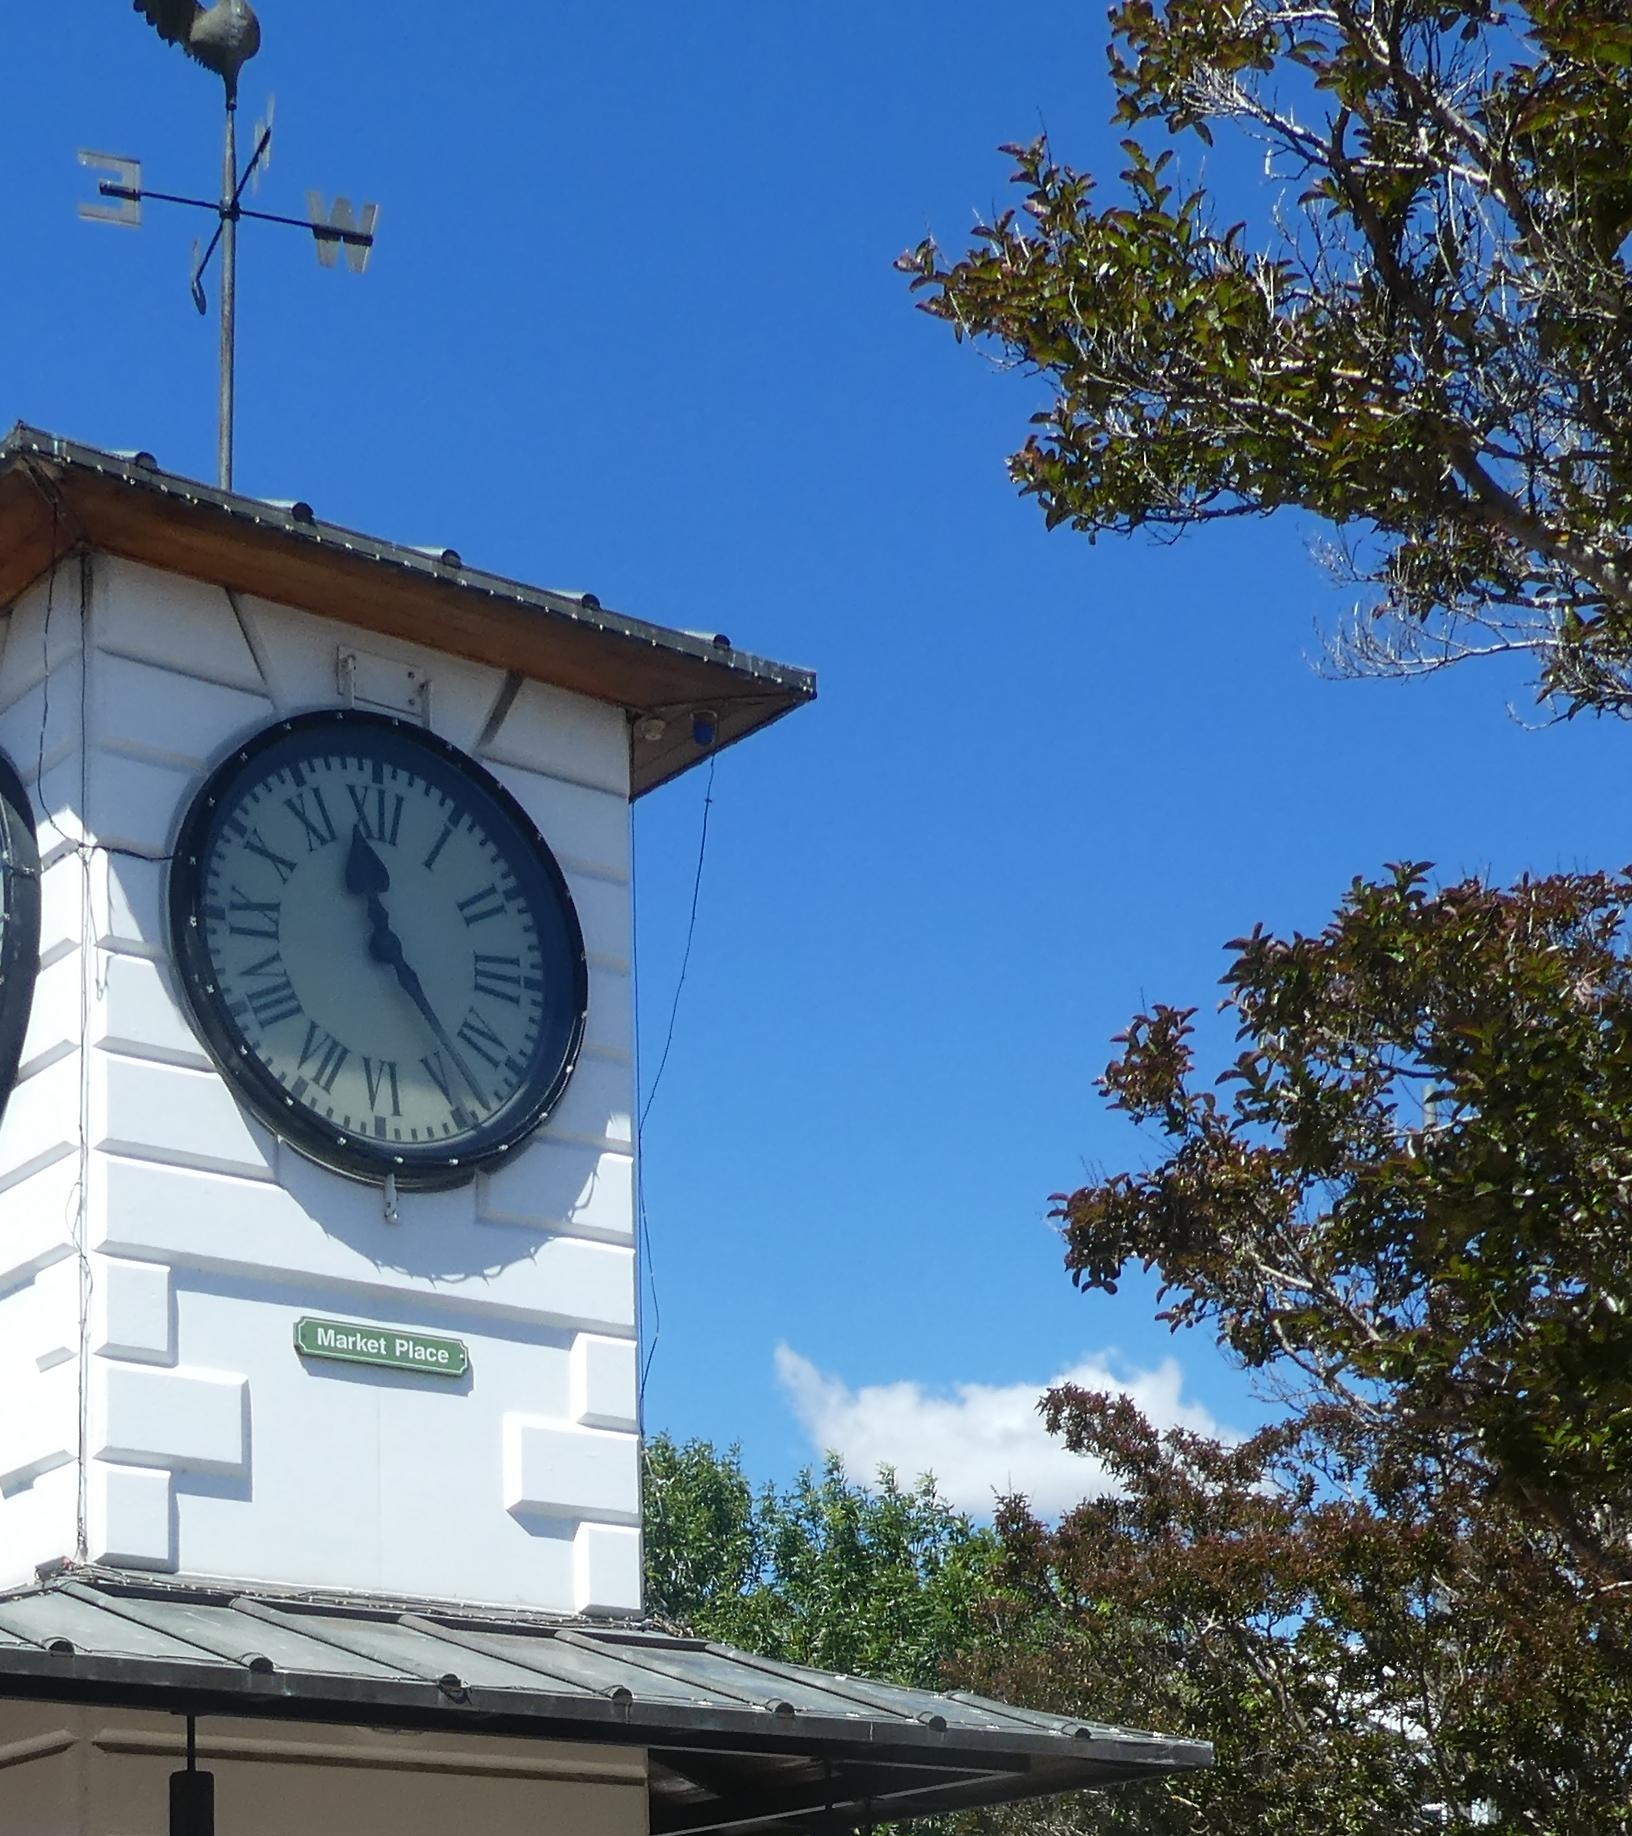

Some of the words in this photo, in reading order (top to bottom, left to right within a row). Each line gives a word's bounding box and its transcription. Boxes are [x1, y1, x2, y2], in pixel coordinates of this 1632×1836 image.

[285, 786, 338, 852] XI
[244, 827, 298, 885] X
[229, 885, 281, 941] IX
[457, 883, 507, 928] II
[474, 950, 521, 1005] III
[363, 1056, 403, 1117] VI
[317, 1327, 387, 1355] Market
[395, 1338, 449, 1363] Place
